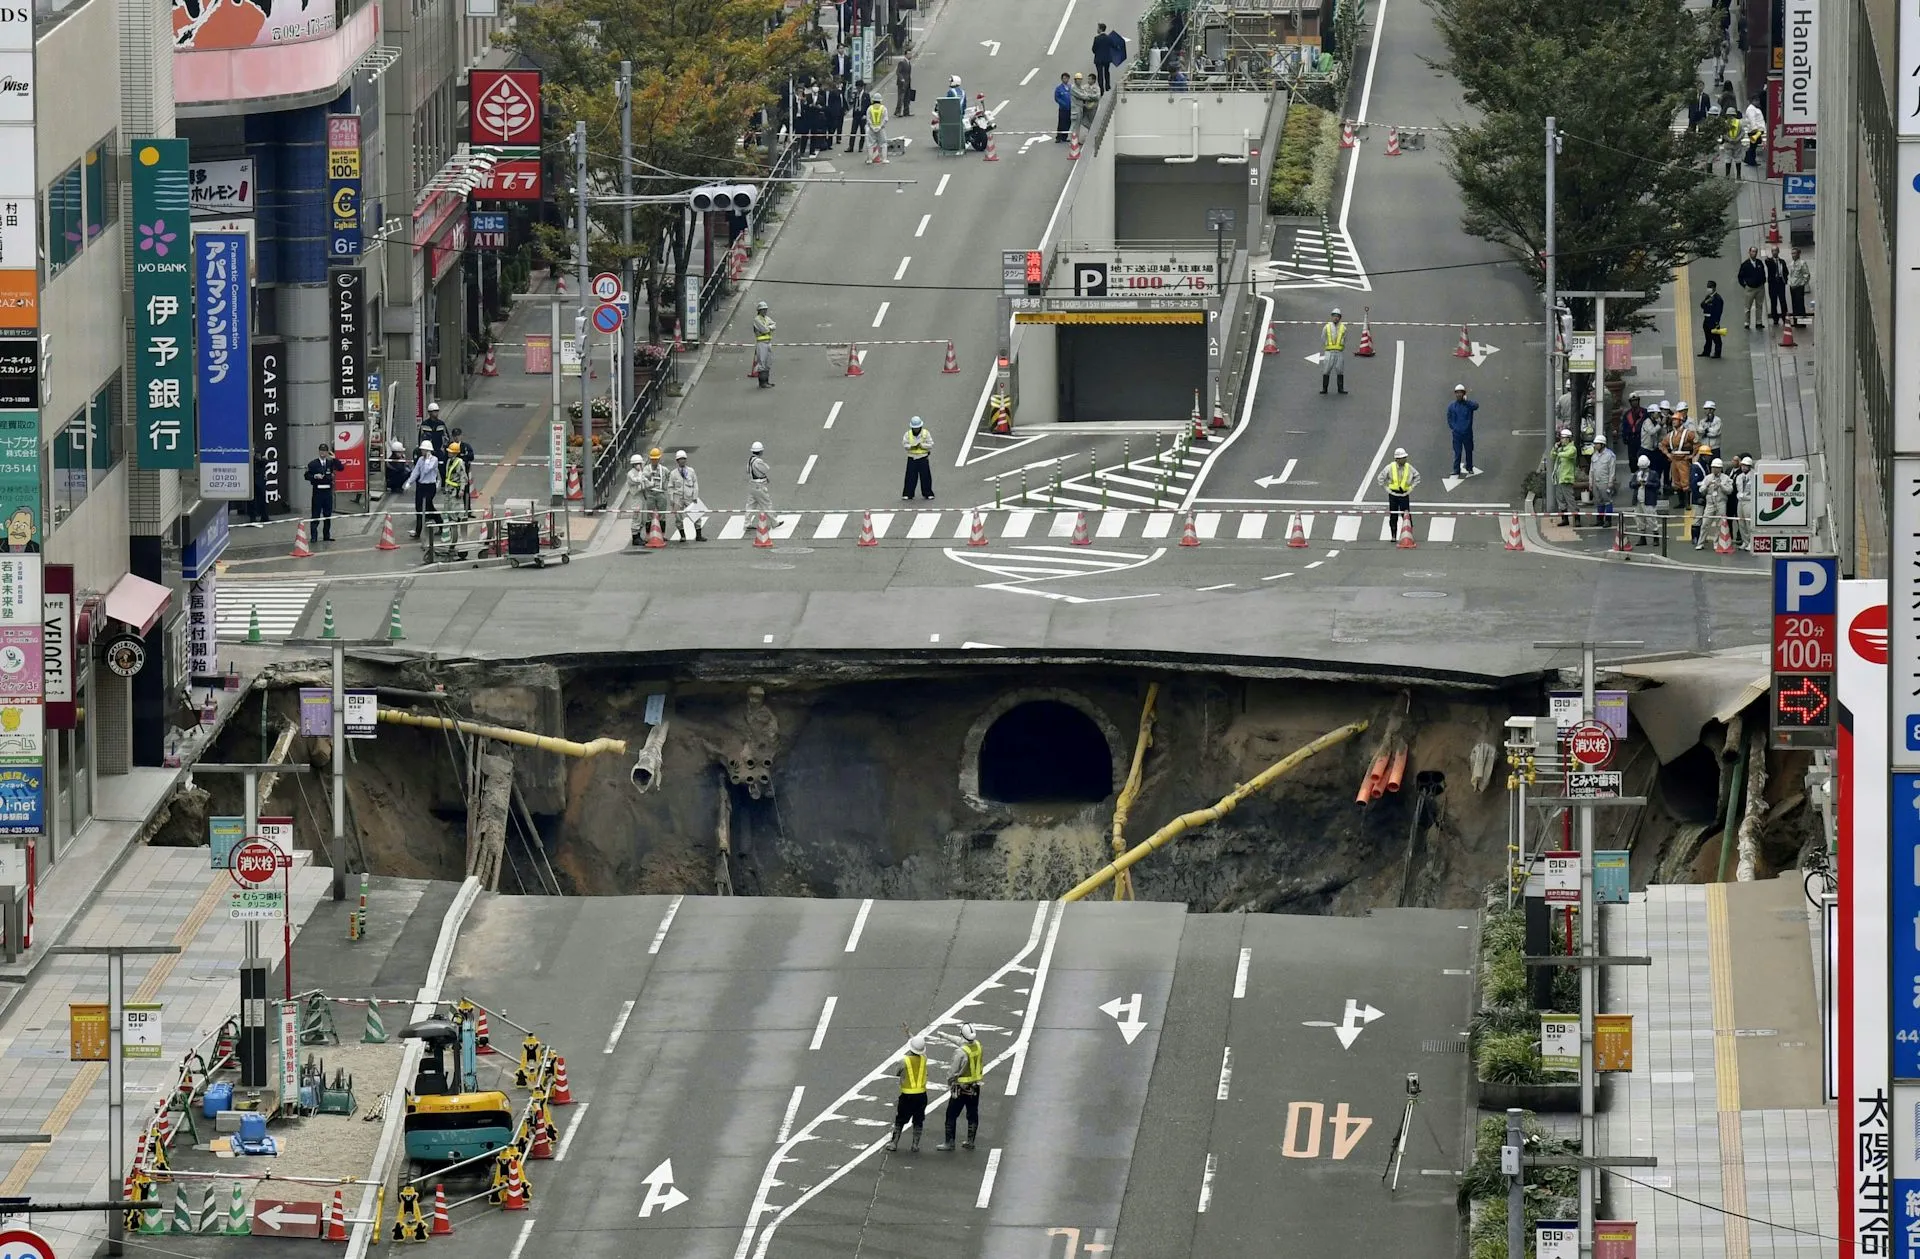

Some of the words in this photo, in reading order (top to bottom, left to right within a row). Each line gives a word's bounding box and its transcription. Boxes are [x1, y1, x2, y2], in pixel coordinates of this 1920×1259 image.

[1792, 10, 1812, 115] HanaTour
[4, 80, 29, 92] Wise
[331, 119, 357, 133] 24h
[331, 165, 358, 177] 100円
[1251, 167, 1258, 186] 出口
[1788, 177, 1802, 193] P
[191, 185, 238, 202] ホルモン
[6, 203, 17, 226] 村田
[335, 238, 358, 254] 6F
[474, 233, 504, 247] ATM
[138, 264, 156, 273] IYO
[158, 264, 187, 273] BANK
[599, 281, 616, 295] 40
[205, 242, 229, 384] アパマンショップ
[341, 290, 356, 334] CAFÉ
[1210, 310, 1218, 323] P
[341, 338, 353, 352] de
[1209, 337, 1219, 356] 入口
[147, 295, 181, 451] 伊予銀行
[341, 355, 356, 396] CRIÉ
[263, 355, 280, 417] CAFÉ
[264, 429, 275, 441] de
[6, 450, 37, 458] 株式会社
[264, 449, 282, 505] CRIÉ
[1792, 538, 1809, 552] ATM
[2, 561, 14, 619] 若者未来塾
[1786, 561, 1827, 612] P
[1785, 618, 1825, 637] 20分
[1777, 640, 1833, 669] 100円
[1575, 738, 1607, 753] 消火栓
[1570, 774, 1619, 787] とみや歯科
[240, 855, 274, 871] 消火栓
[243, 892, 282, 901] むらつ歯科
[1282, 1102, 1373, 1160] 40
[1858, 1088, 1889, 1259] 太陽生命
